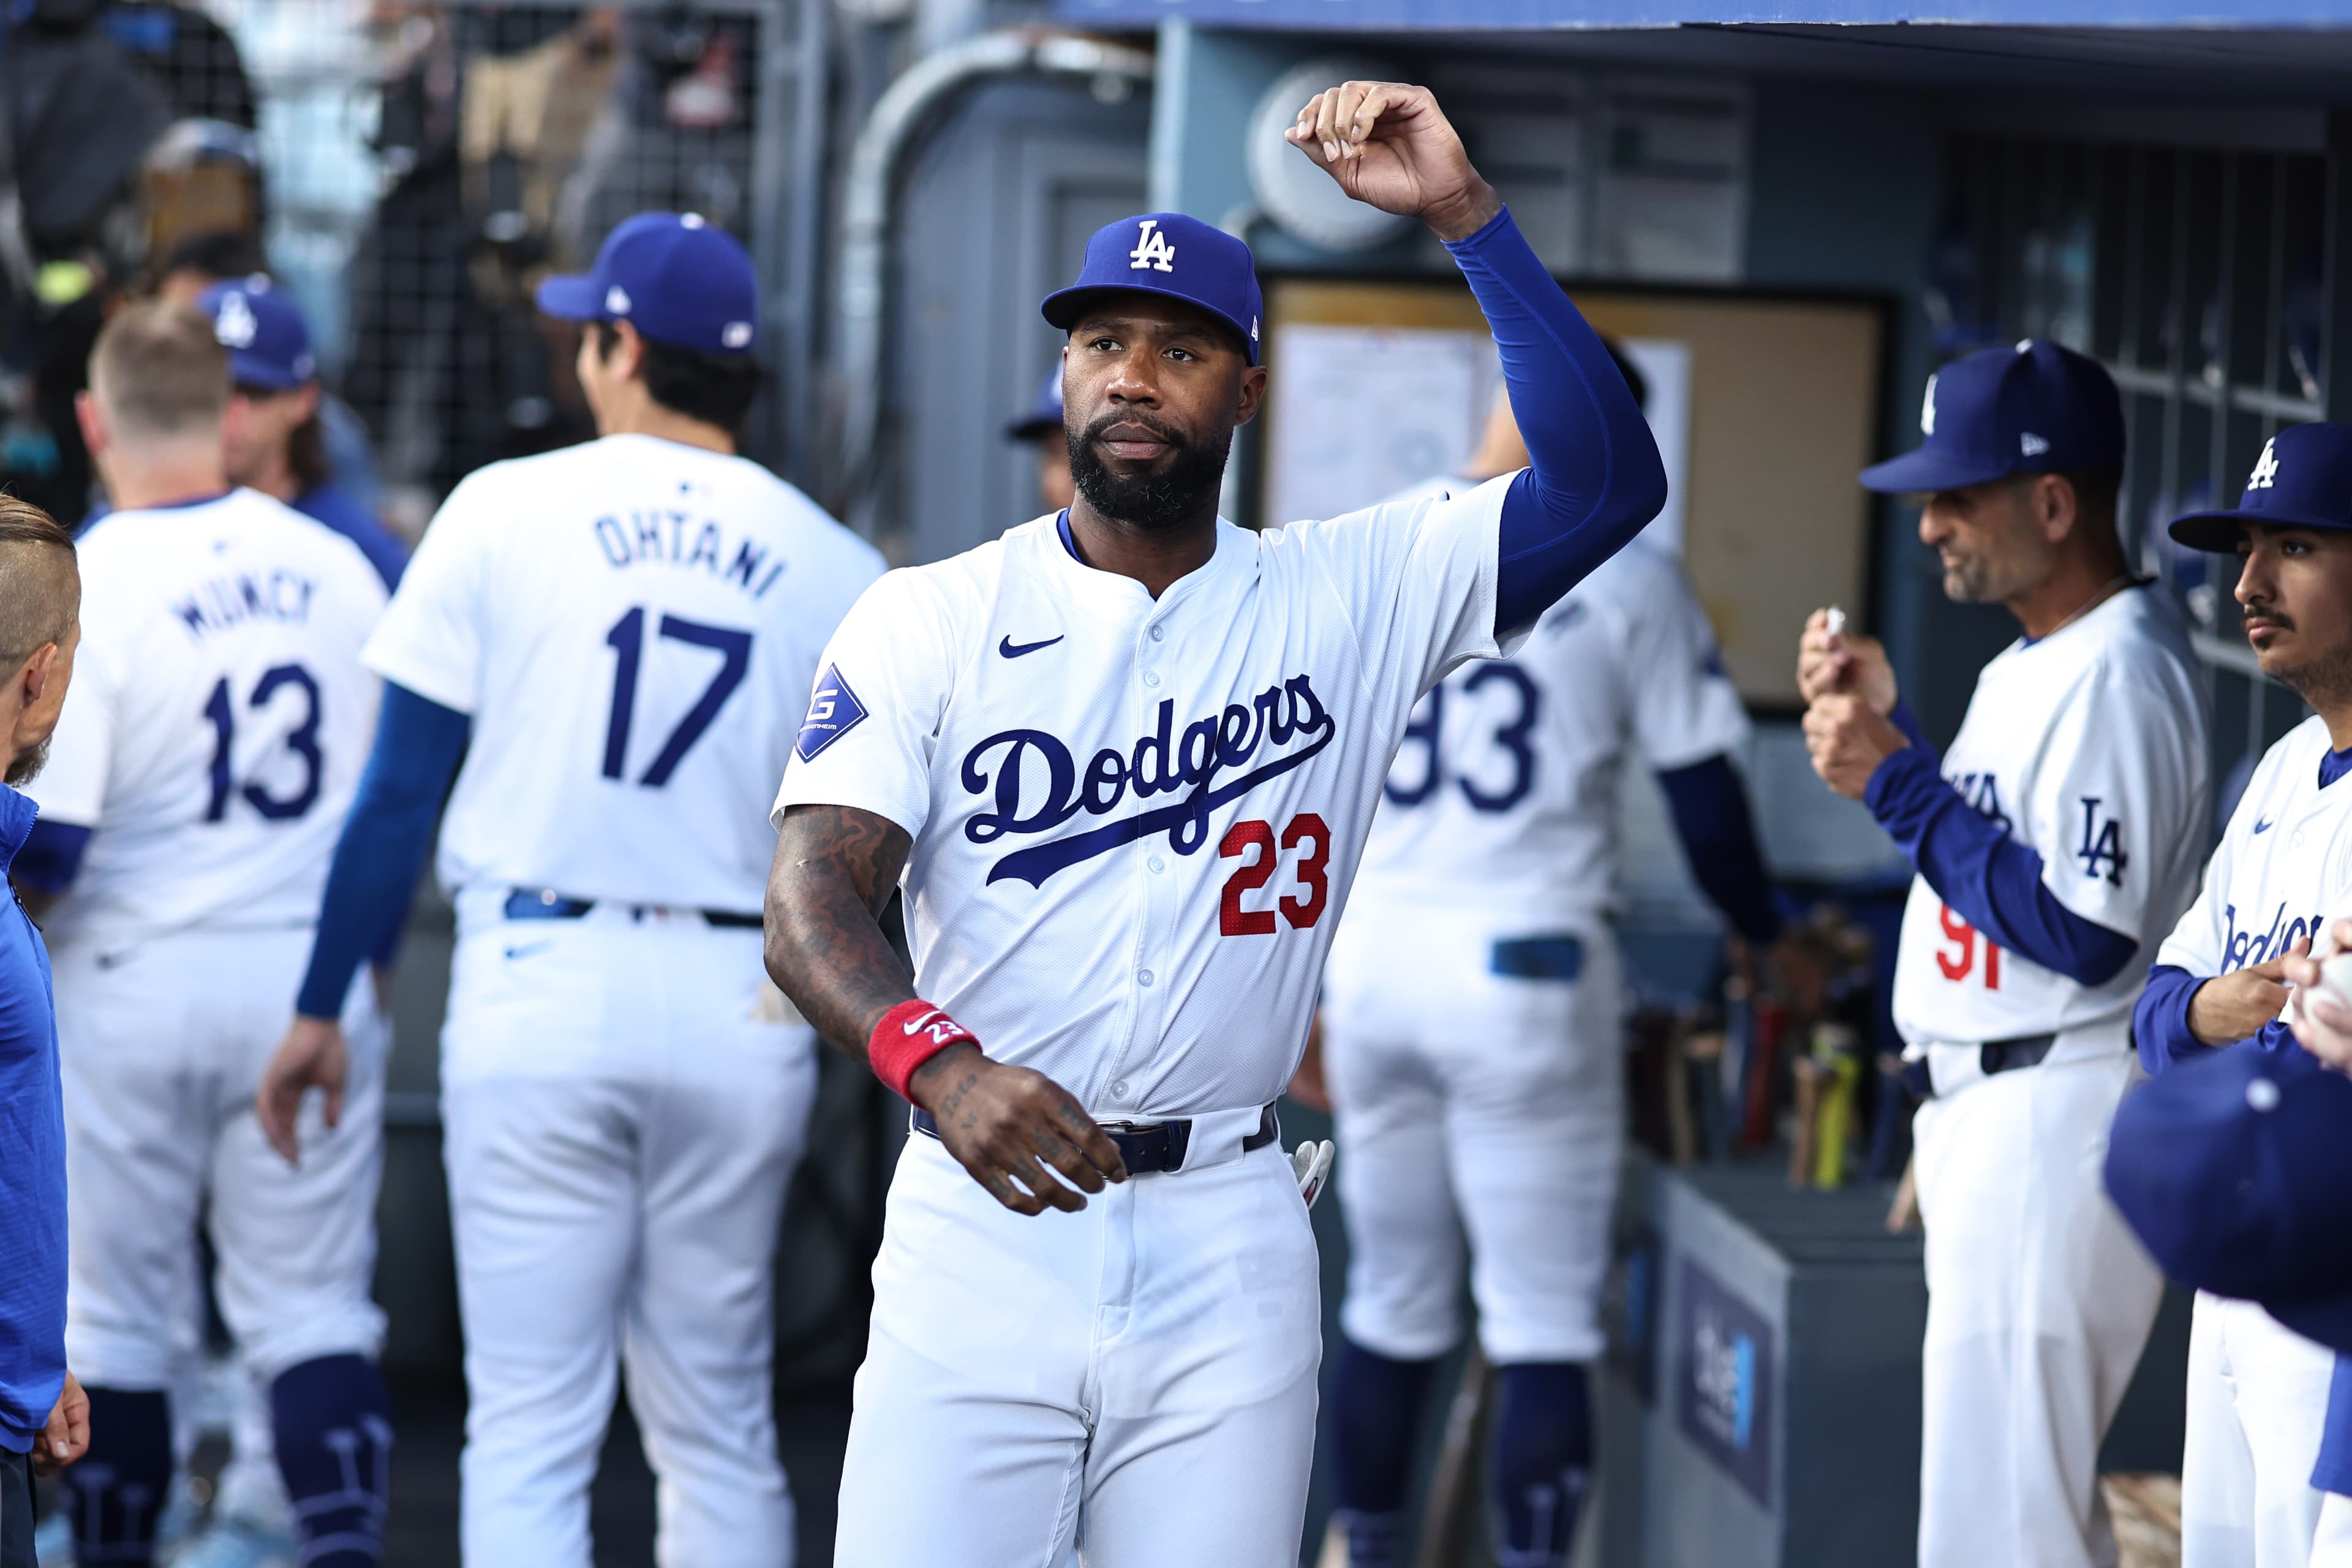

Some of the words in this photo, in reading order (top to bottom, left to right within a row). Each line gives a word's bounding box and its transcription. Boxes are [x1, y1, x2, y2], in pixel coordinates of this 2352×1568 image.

[1130, 220, 1175, 273] LA
[2247, 435, 2279, 491] LA
[595, 512, 787, 598] OHTANI
[171, 573, 324, 637] MUNCY
[602, 606, 754, 786] 17
[204, 663, 323, 821] 13
[961, 674, 1335, 858] Dodgers
[1219, 813, 1332, 937] 23
[2078, 798, 2128, 888] LA
[924, 1020, 965, 1044] 23
